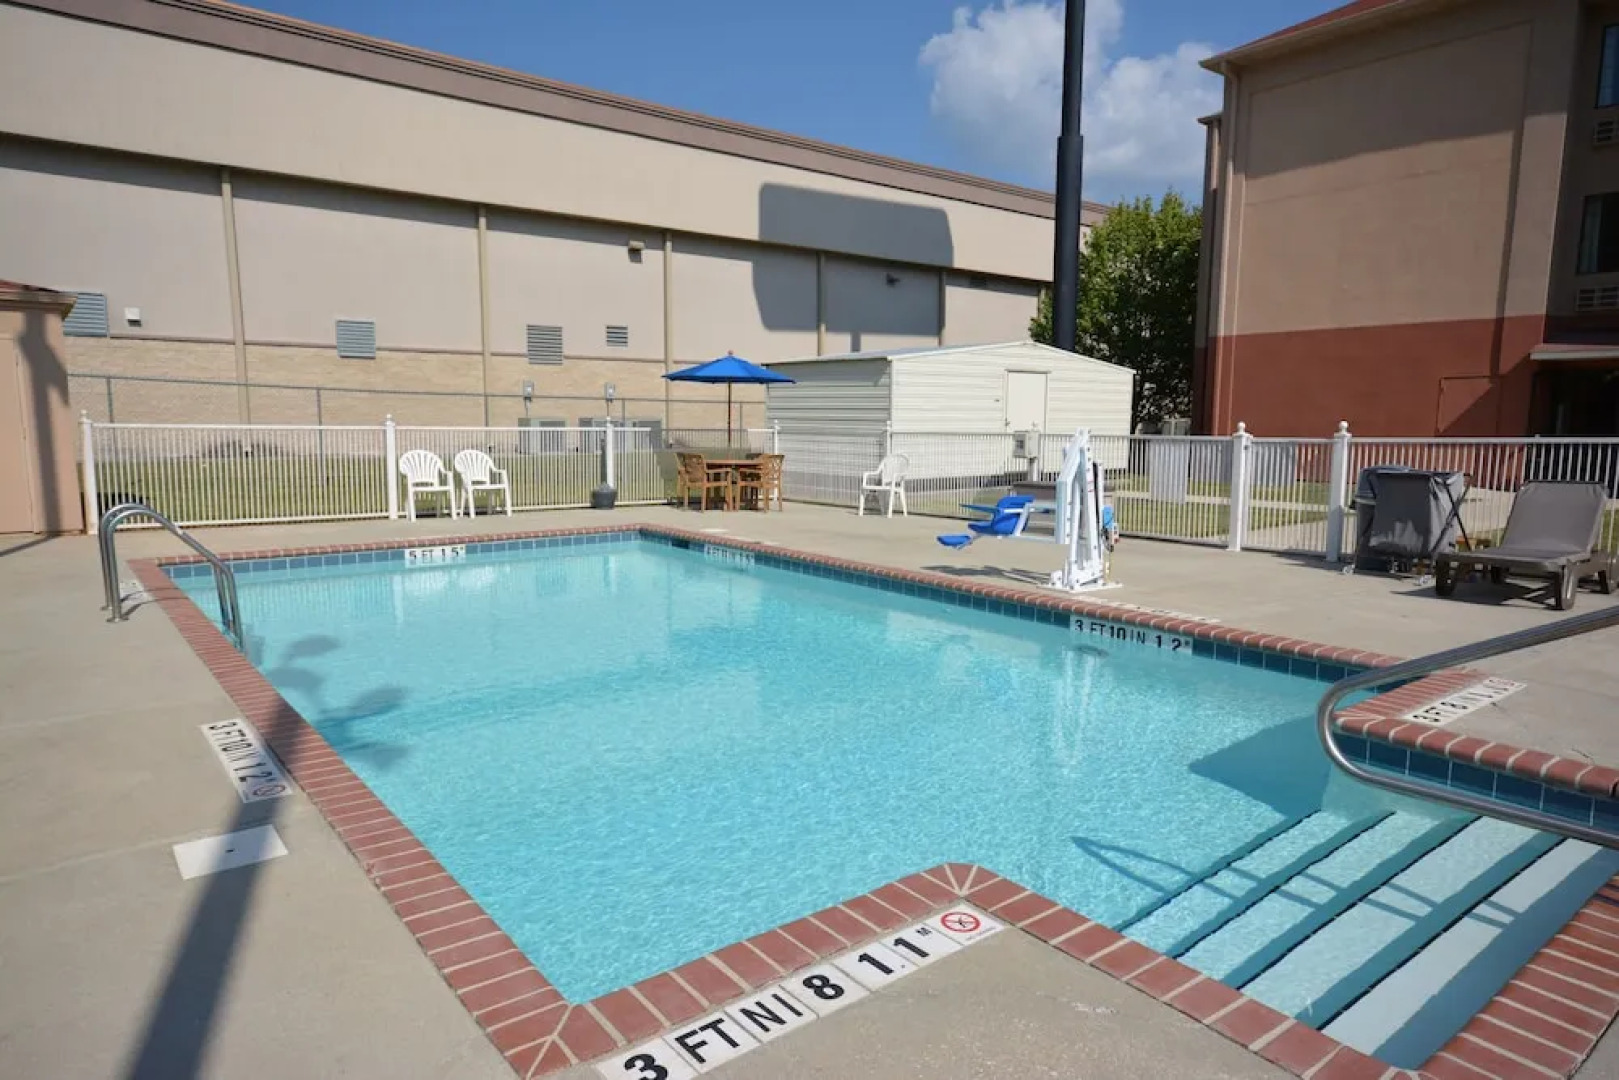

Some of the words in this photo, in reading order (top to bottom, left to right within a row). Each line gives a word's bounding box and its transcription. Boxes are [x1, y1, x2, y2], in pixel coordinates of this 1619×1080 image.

[1075, 619, 1083, 632] 3
[1090, 622, 1106, 635] FT
[624, 1053, 668, 1080] 3
[674, 1018, 740, 1064] FT
[802, 974, 845, 1000] 8
